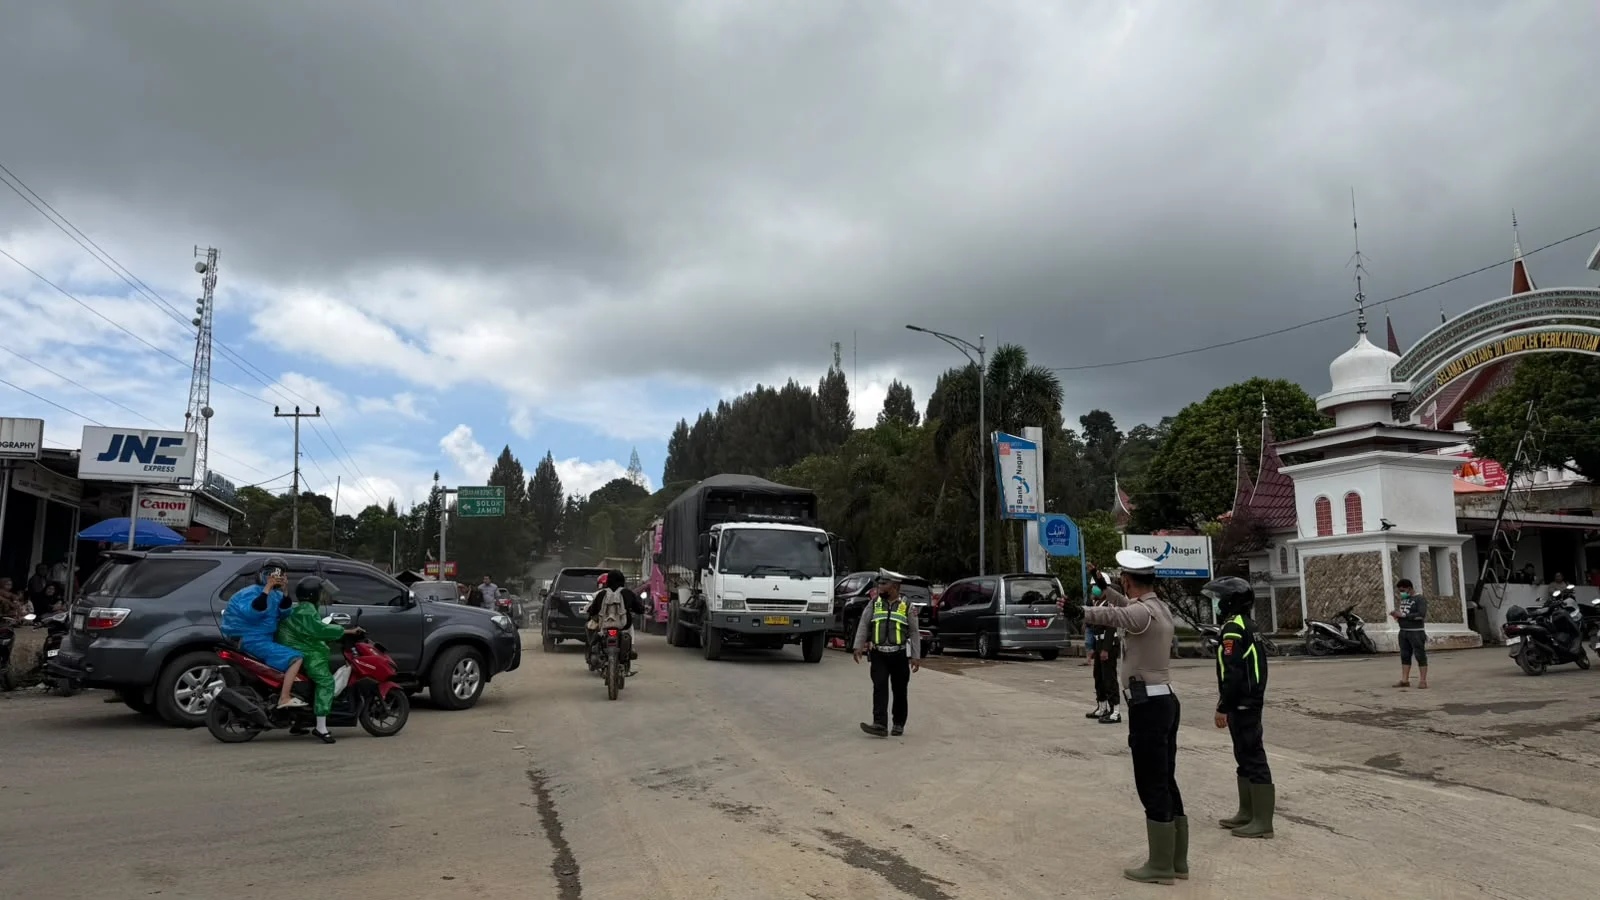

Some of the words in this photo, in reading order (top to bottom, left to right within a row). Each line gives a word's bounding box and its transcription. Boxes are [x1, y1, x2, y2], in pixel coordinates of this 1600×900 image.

[1436, 358, 1466, 385] SELAMAT
[1464, 343, 1494, 369] DATANG
[1494, 341, 1504, 357] DI
[1504, 333, 1539, 354] KOMPLEK
[1540, 331, 1600, 351] PERKANTORAN
[97, 433, 188, 466] JNE
[143, 464, 176, 473] EXPRESS
[140, 498, 187, 511] Canon
[1134, 545, 1159, 555] Bank
[1171, 546, 1202, 556] Nagari
